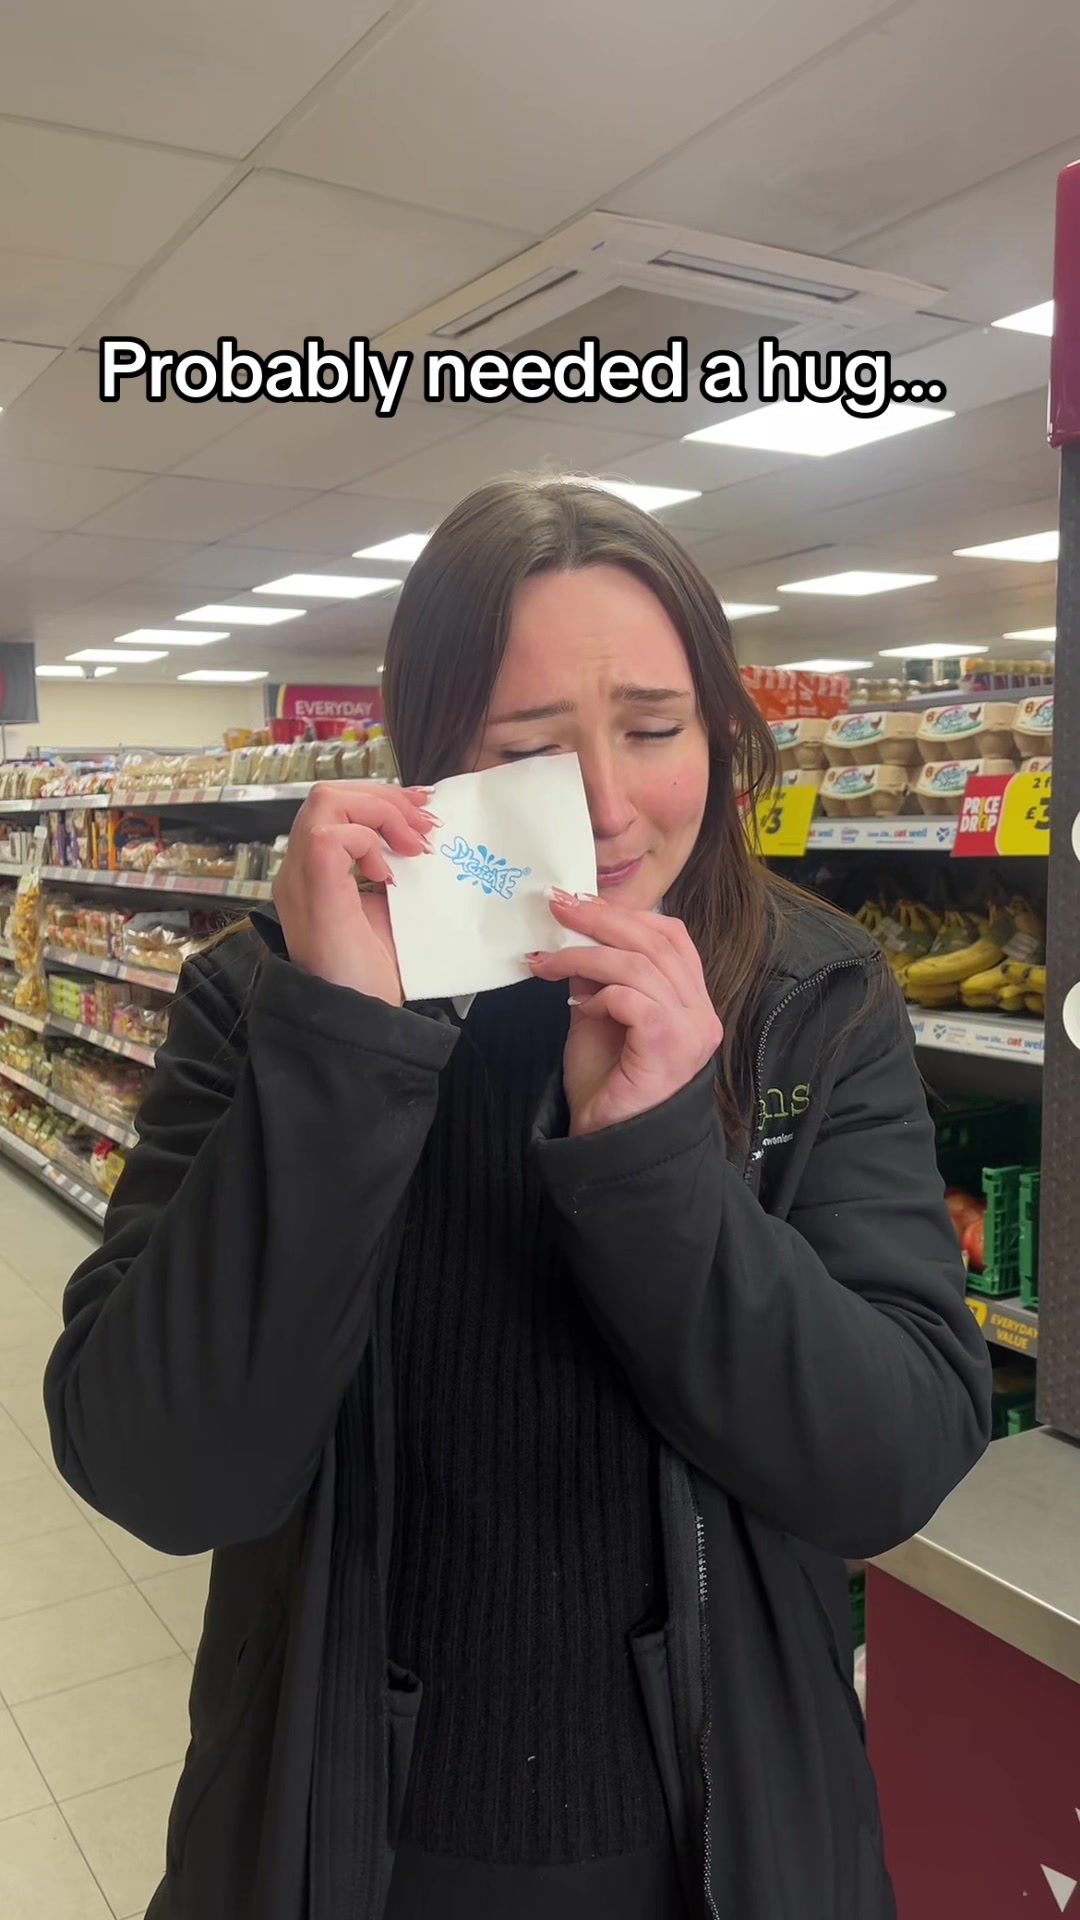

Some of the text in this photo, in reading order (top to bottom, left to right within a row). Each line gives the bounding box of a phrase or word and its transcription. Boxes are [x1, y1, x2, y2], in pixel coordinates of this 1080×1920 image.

[294, 700, 373, 717] EVERYDAY
[962, 795, 1001, 814] PRICE
[990, 1313, 1039, 1339] EVERYDAY
[995, 1329, 1030, 1350] VALUE
